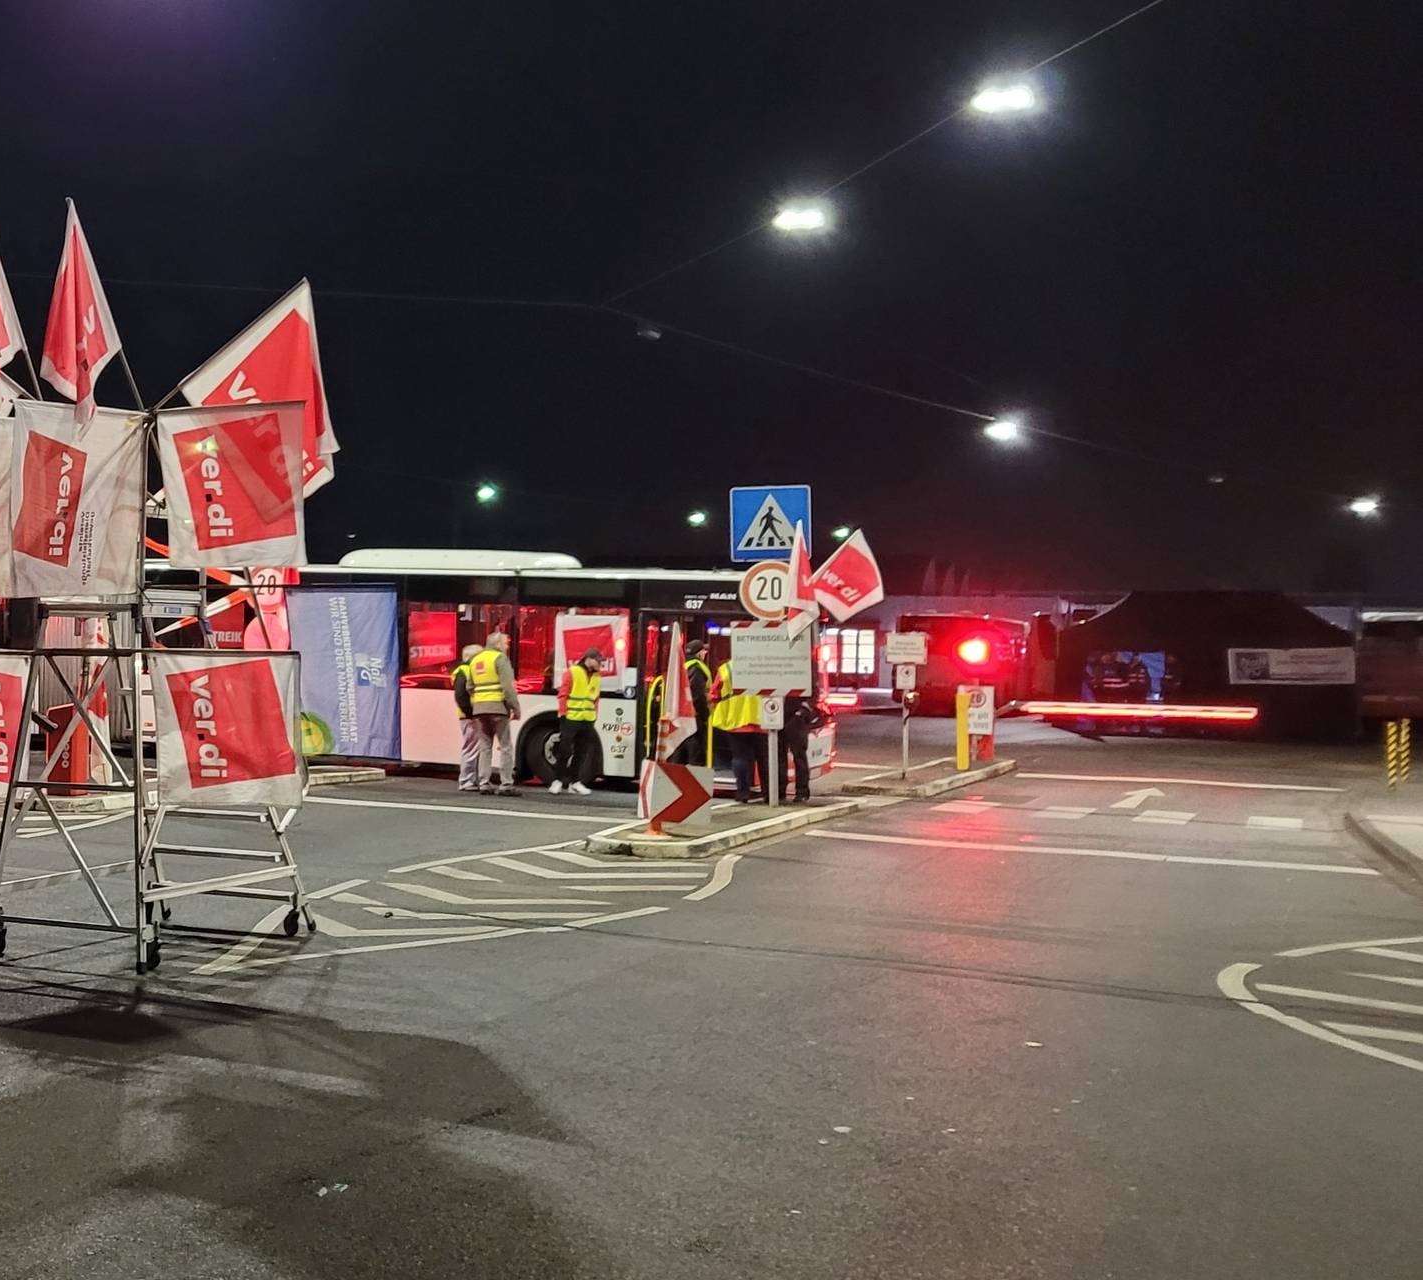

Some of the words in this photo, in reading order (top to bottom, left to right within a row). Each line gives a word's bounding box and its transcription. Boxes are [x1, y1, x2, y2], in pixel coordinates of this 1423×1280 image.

[196, 434, 234, 537] ver.di
[257, 574, 276, 596] 20
[756, 576, 782, 600] 20
[214, 630, 242, 642] TREIK
[410, 644, 452, 658] STREIK
[190, 674, 228, 778] ver.di
